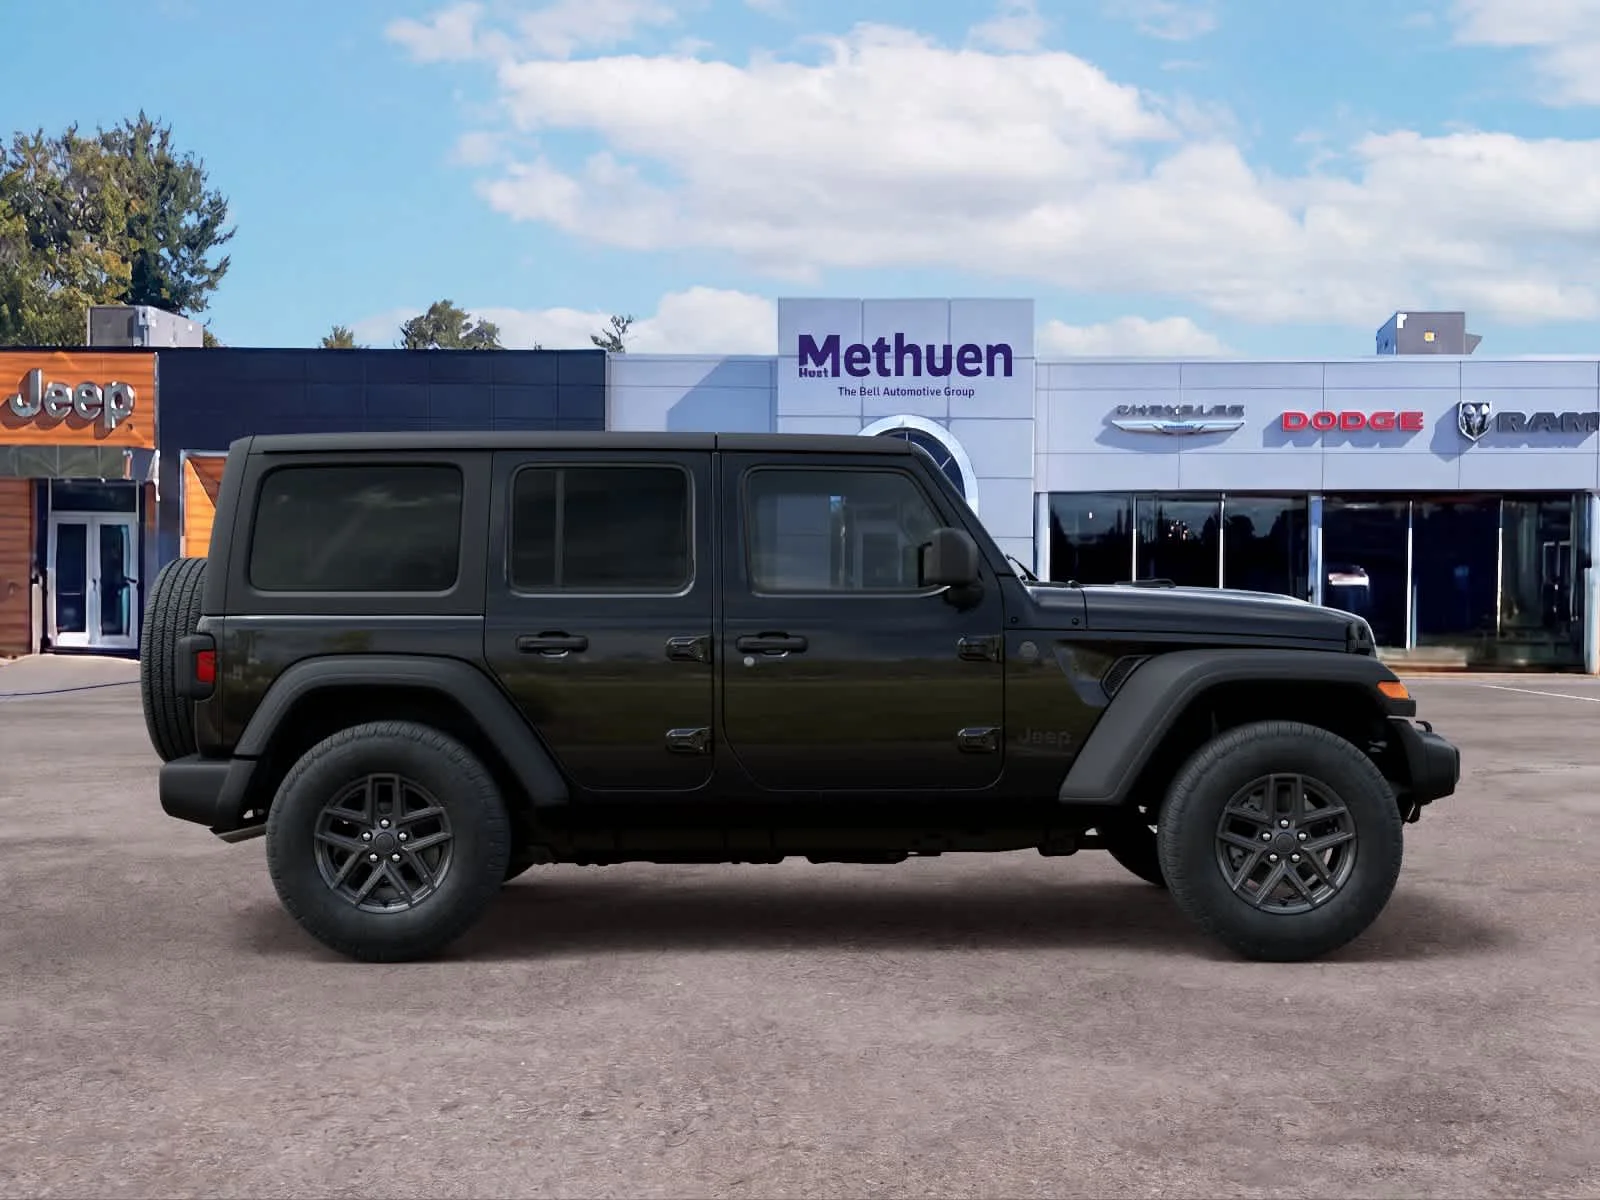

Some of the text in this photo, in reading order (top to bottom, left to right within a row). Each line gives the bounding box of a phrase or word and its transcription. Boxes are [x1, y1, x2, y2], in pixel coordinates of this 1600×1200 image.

[798, 333, 1013, 377] Methuen
[9, 368, 135, 429] Jeep
[837, 386, 975, 399] The Bell Automotive Group
[1282, 411, 1424, 432] DODGE
[1496, 411, 1600, 432] RAM
[1018, 728, 1073, 747] Jeep
